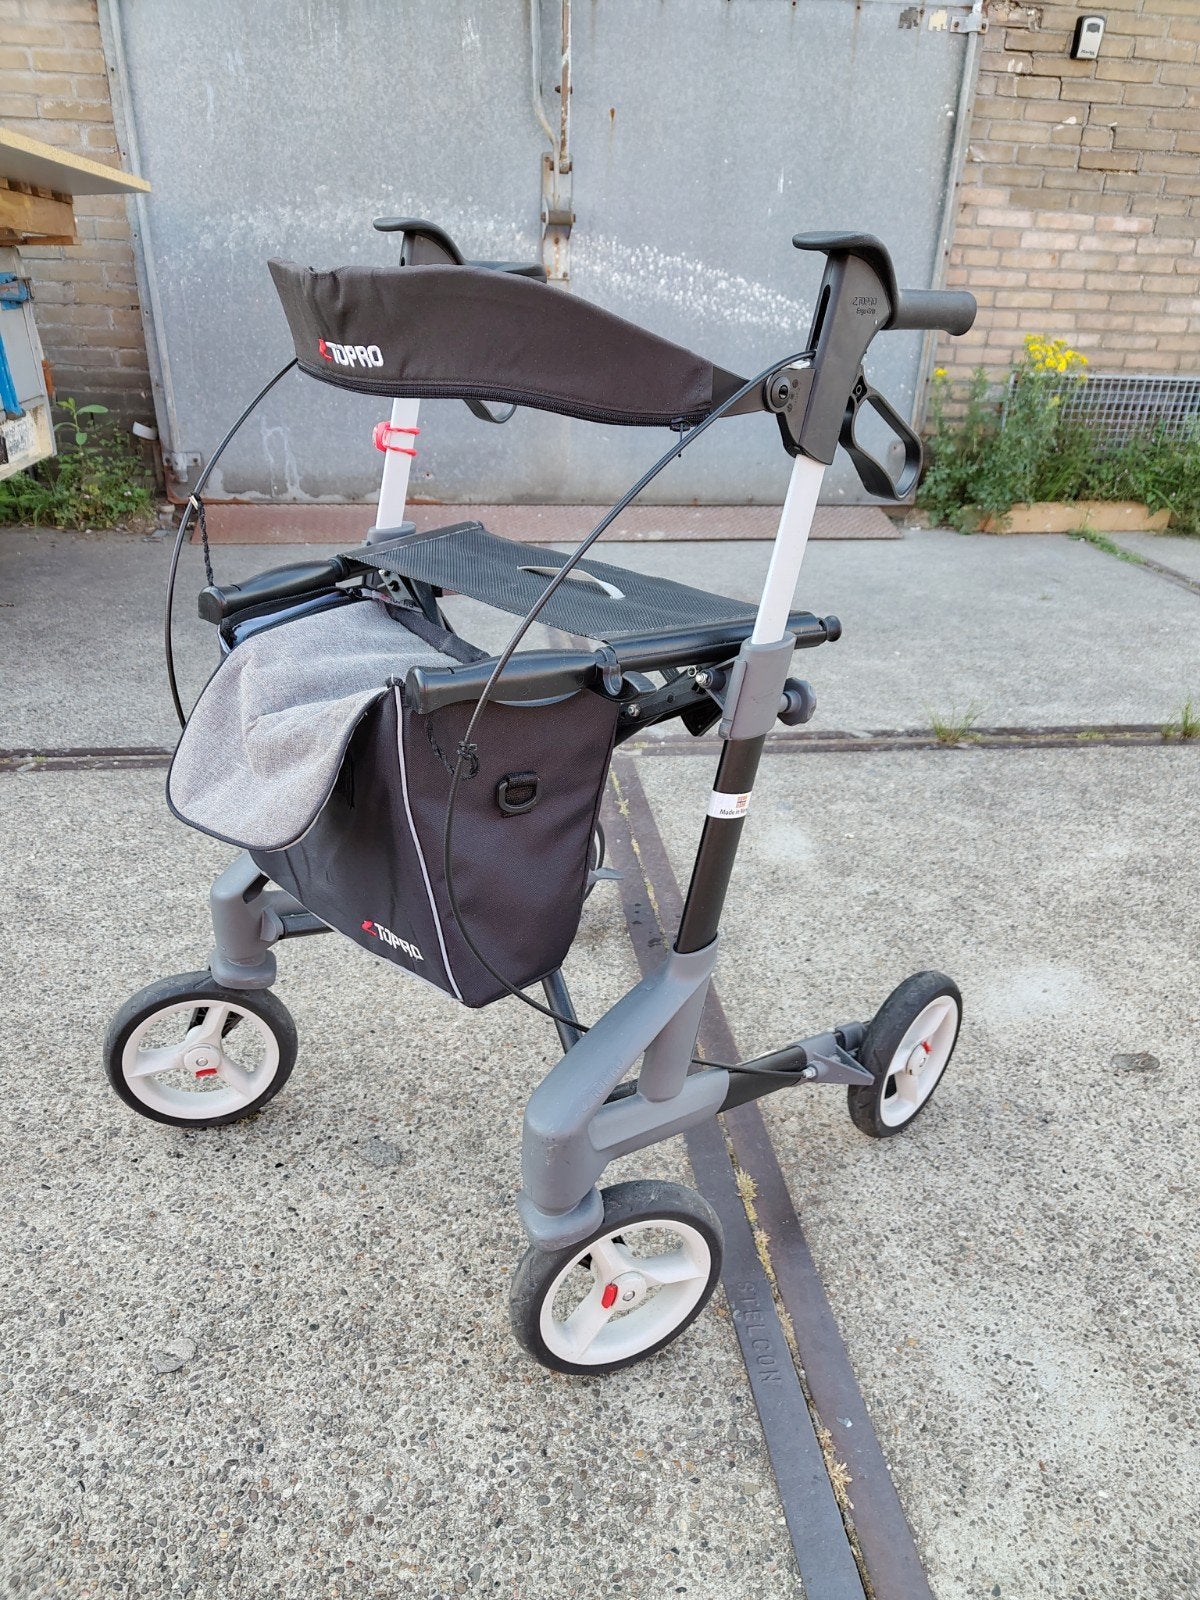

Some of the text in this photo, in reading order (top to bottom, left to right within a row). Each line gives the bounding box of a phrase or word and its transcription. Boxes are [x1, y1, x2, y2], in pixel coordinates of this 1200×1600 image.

[325, 341, 384, 368] TOPRO
[720, 808, 735, 816] Made
[374, 922, 425, 961] TOPRO
[738, 1281, 782, 1383] STELCON
